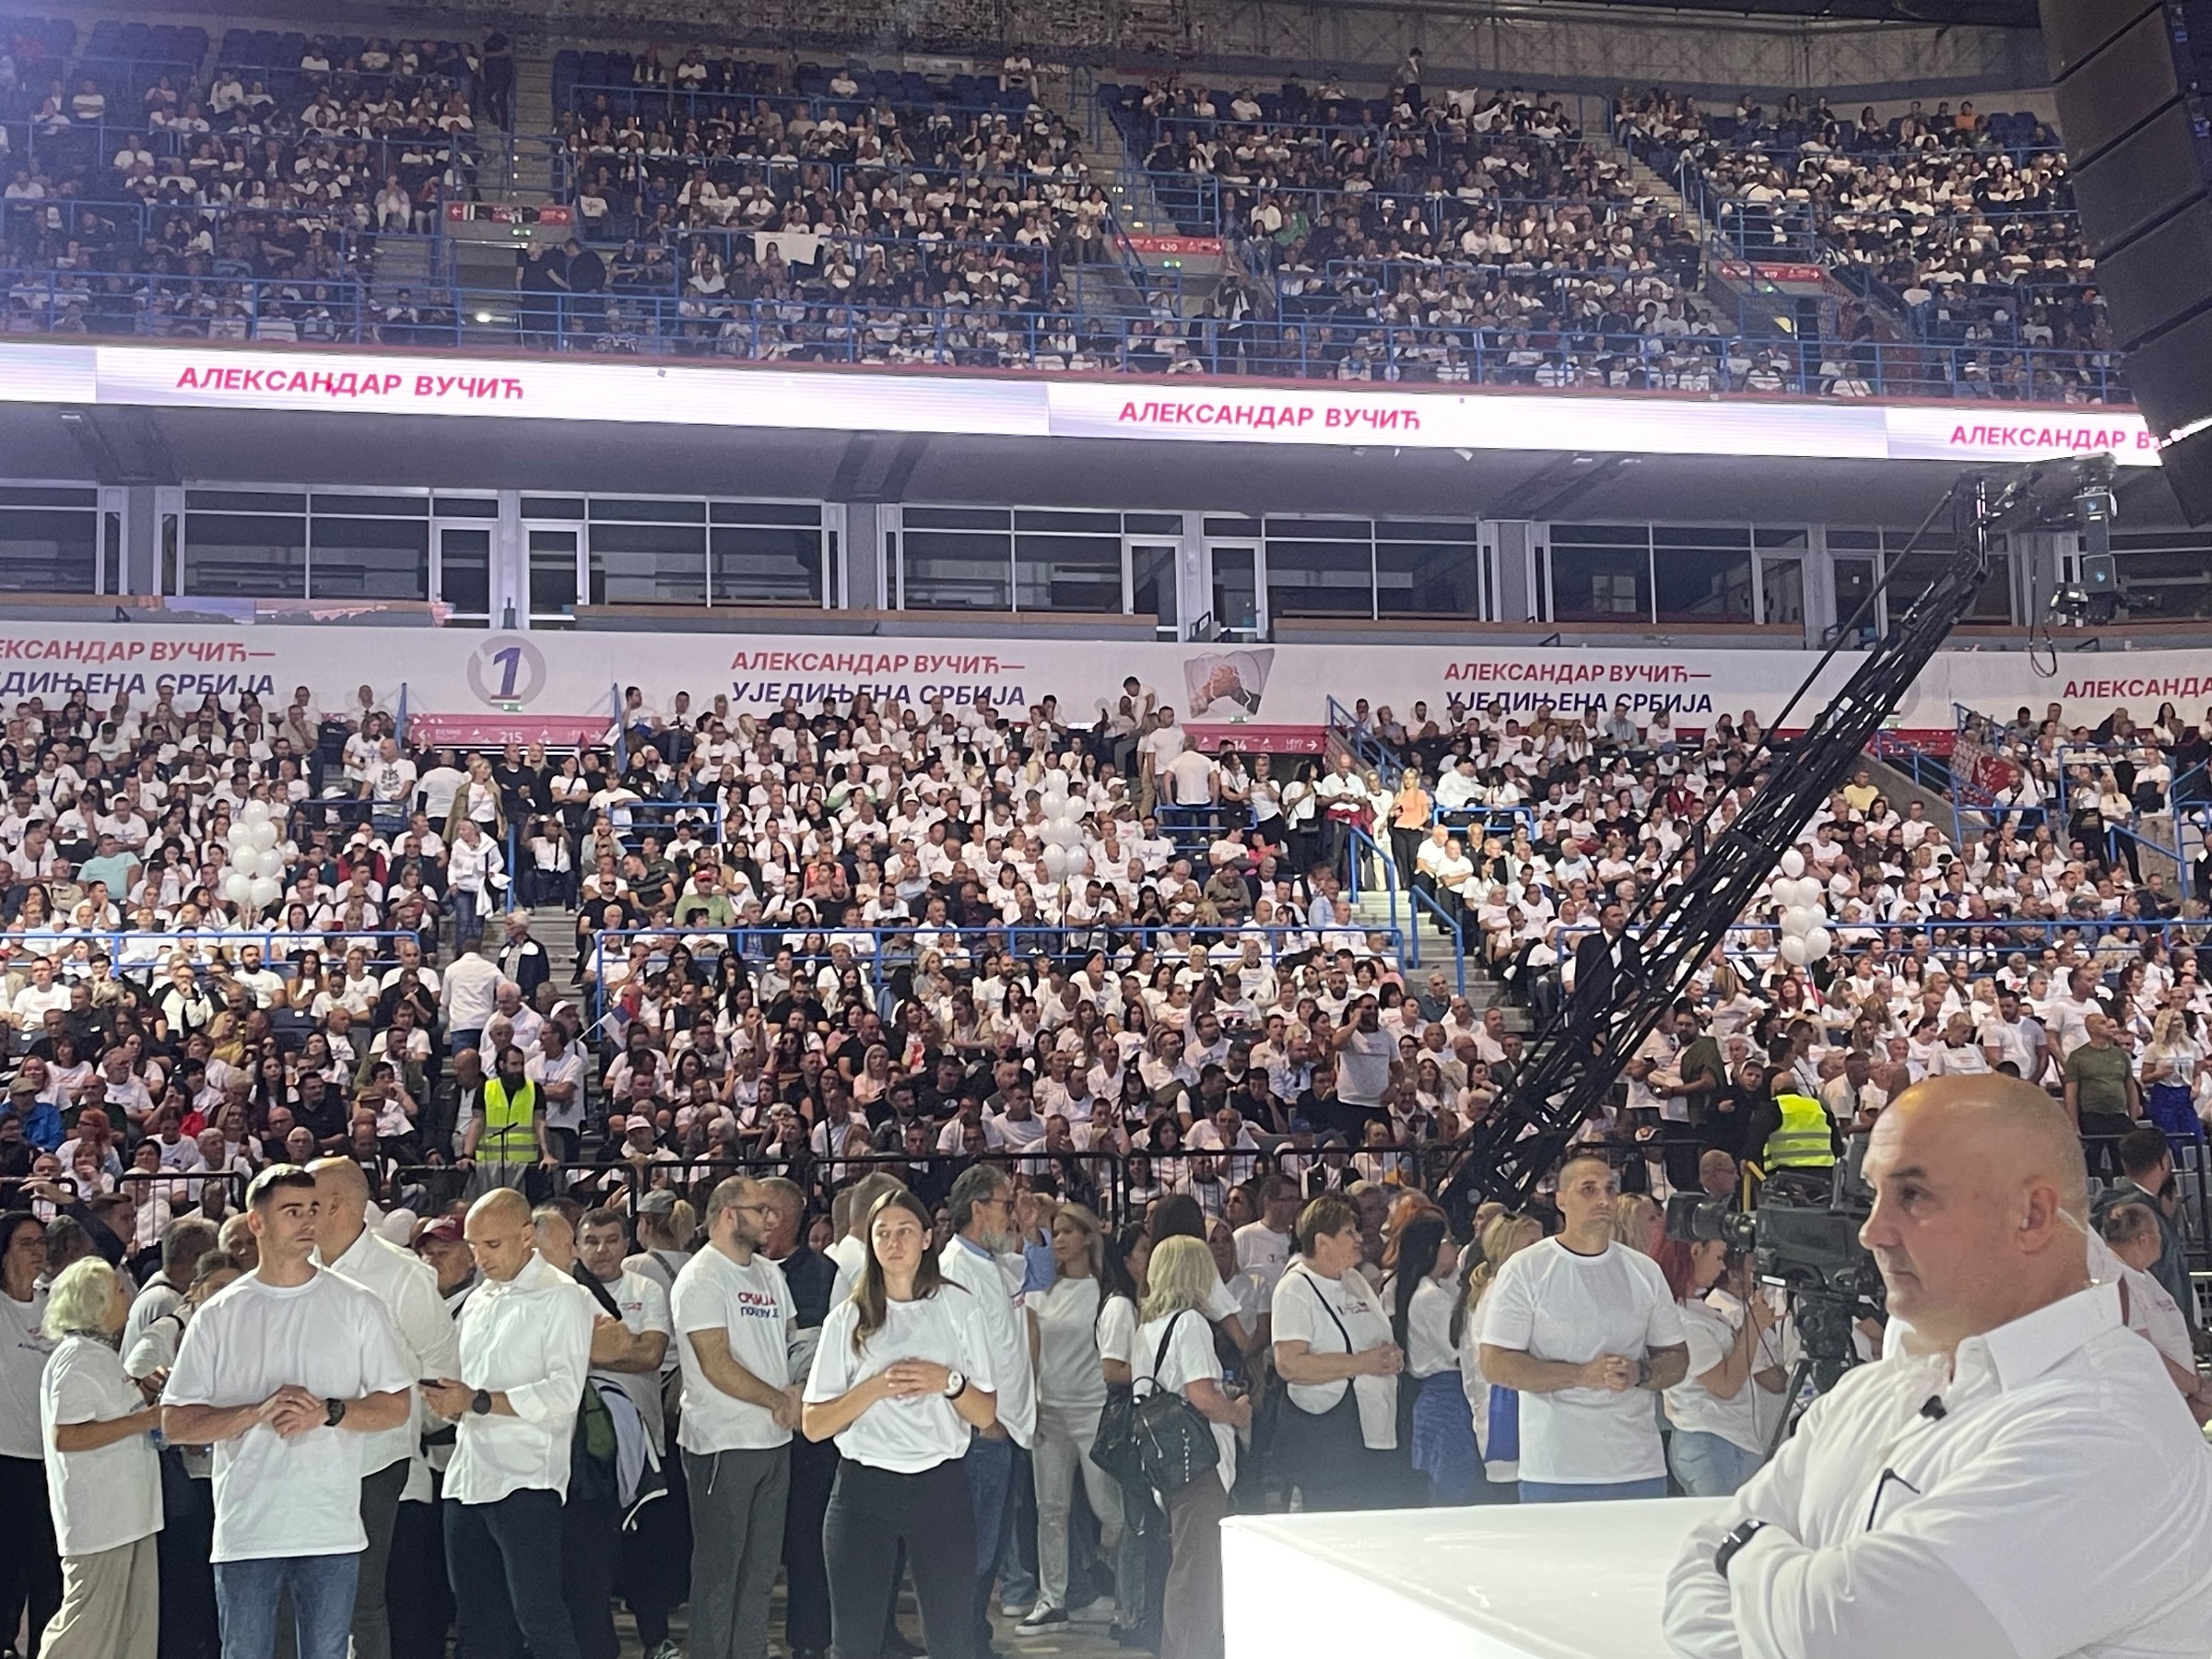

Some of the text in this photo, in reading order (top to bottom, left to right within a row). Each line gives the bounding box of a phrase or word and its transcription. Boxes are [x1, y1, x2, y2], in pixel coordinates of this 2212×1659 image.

[176, 367, 524, 399] АЛЕКСАНДАР ВУЧИЋ
[1118, 402, 1420, 429] АЛЕКСАНДАР ВУЧИЋ
[1949, 426, 2126, 450] АЛЕКСАНДАР
[492, 647, 522, 696] 1
[731, 651, 909, 676] АЛЕКСАНДАР
[1443, 663, 1605, 685] АЛЕКСАНДАР
[0, 671, 275, 697] ДИЊЕНА СРБИЈА
[731, 682, 1026, 707] УЈЕДИЊЕНА СРБИЈА
[1618, 693, 1712, 712] СРБИЈА
[500, 731, 524, 743] 215
